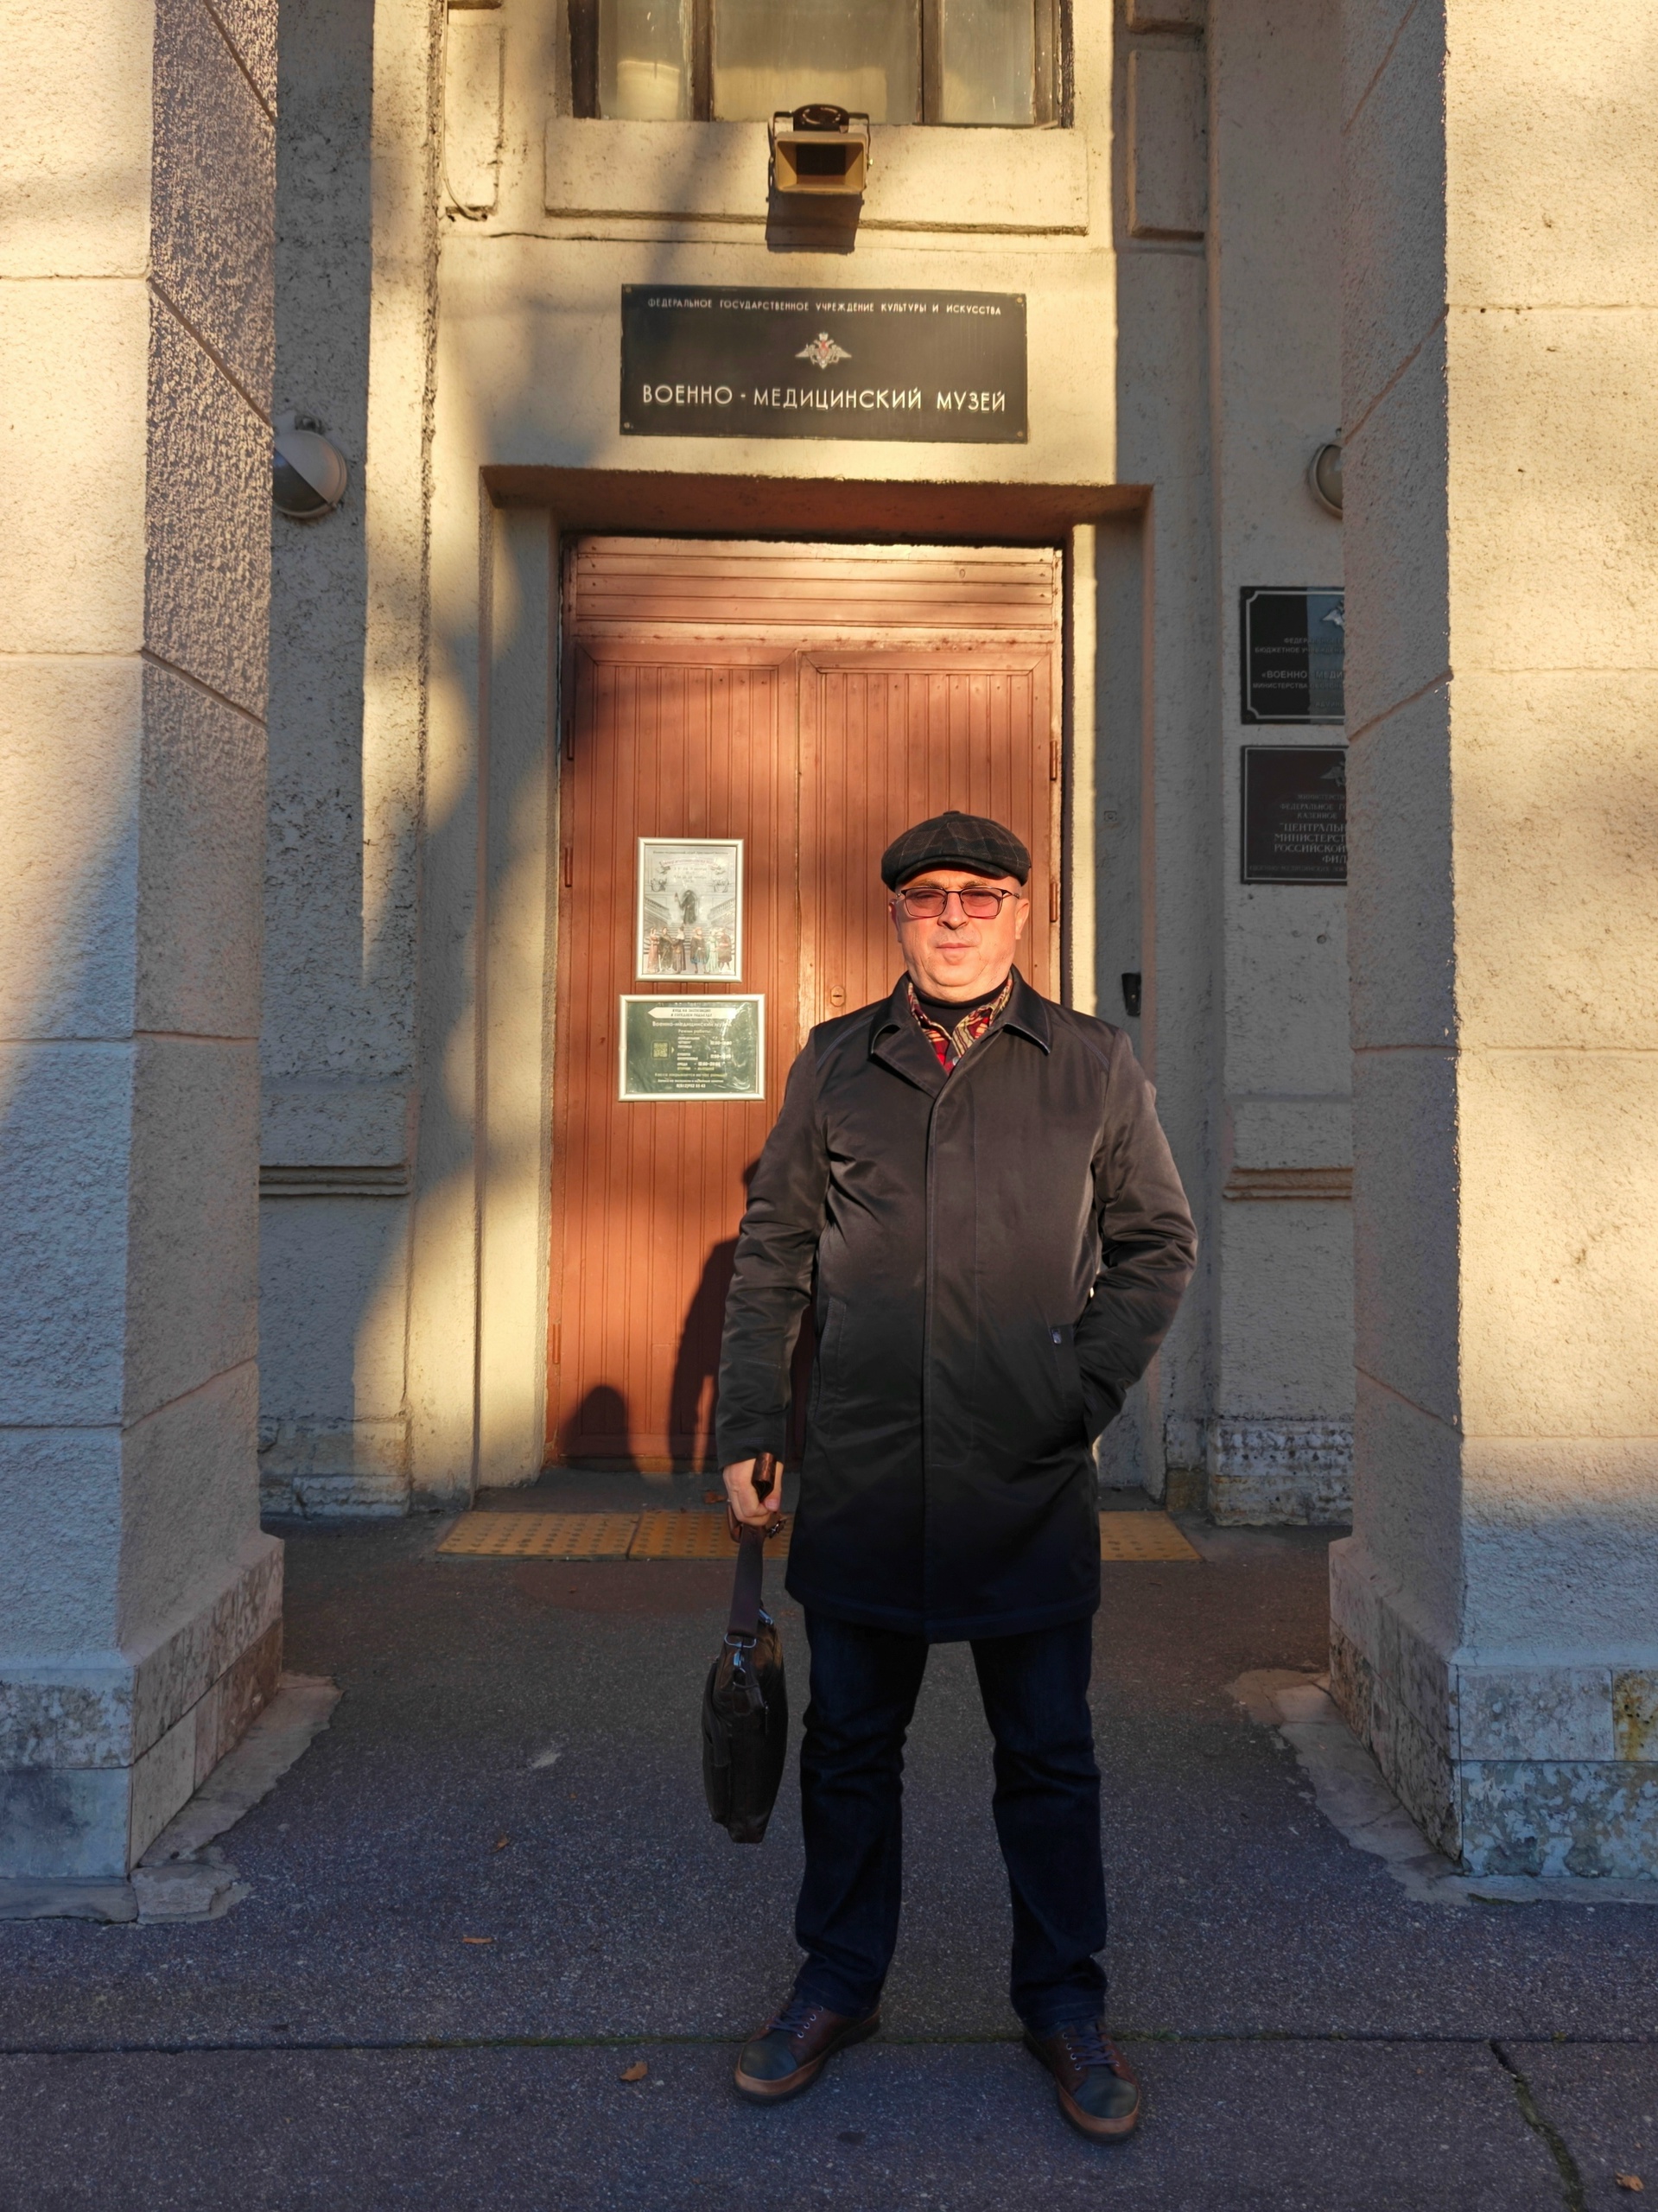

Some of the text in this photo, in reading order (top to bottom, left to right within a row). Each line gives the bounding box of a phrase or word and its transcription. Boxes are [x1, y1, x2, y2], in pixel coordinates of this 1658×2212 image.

[648, 297, 1001, 315] ФЕДЕРАЛЬНОЕ ГОСУДАРСТВЕННОЕ УЧРЕЖДЕНИЕ КУЛЬТУРЫ И ИСКУССТВА
[643, 385, 733, 404] ВОЕННО
[753, 386, 922, 410] МЕДИЦИНСКИЙ
[937, 391, 1006, 412] МУЗЕЙ
[1297, 811, 1338, 820] КАЗЕННОЕ
[1274, 843, 1345, 853] РОССИЙСКОЙ
